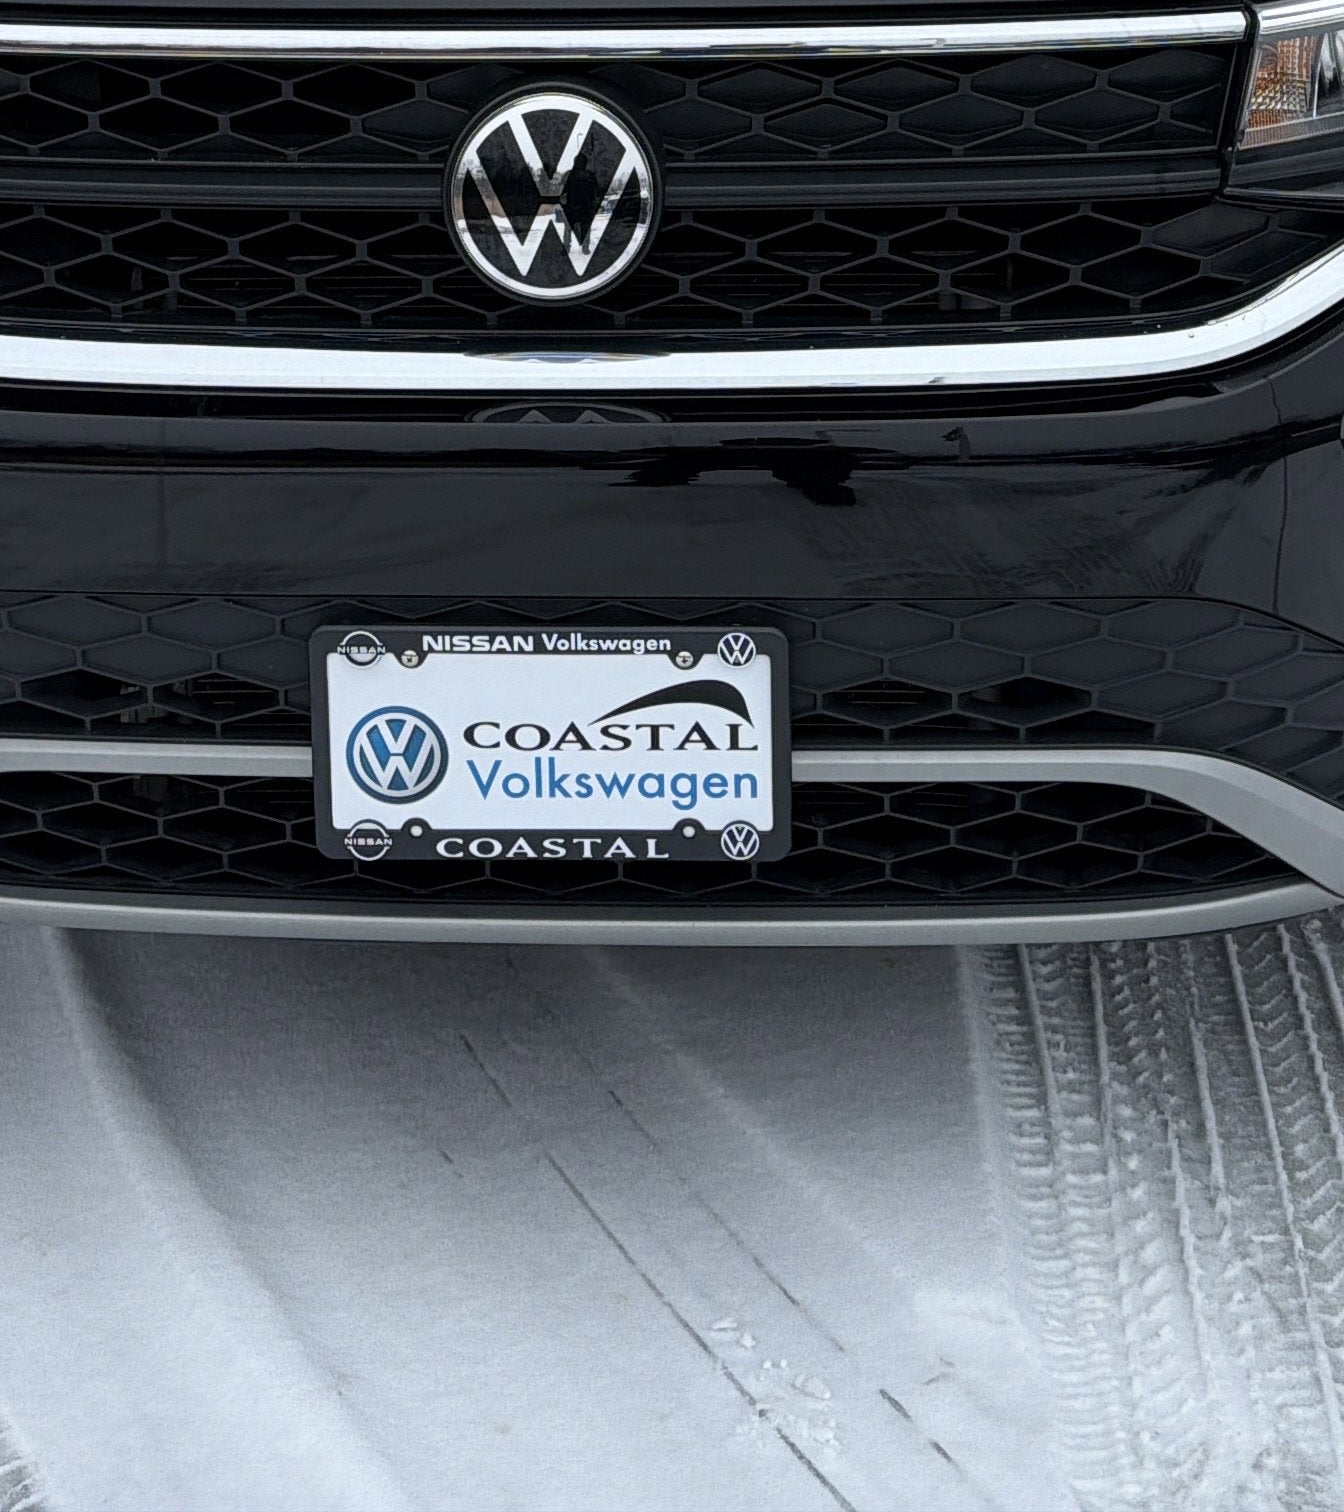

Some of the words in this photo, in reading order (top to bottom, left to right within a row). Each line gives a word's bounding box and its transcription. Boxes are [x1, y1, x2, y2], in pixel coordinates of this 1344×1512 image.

[451, 92, 654, 299] VW
[422, 634, 534, 652] NISSAN
[541, 632, 672, 655] Volkswagen
[346, 705, 449, 805] VW
[462, 720, 759, 752] COASTAL
[466, 756, 758, 811] Volkswagen
[435, 836, 670, 859] COASTAL
